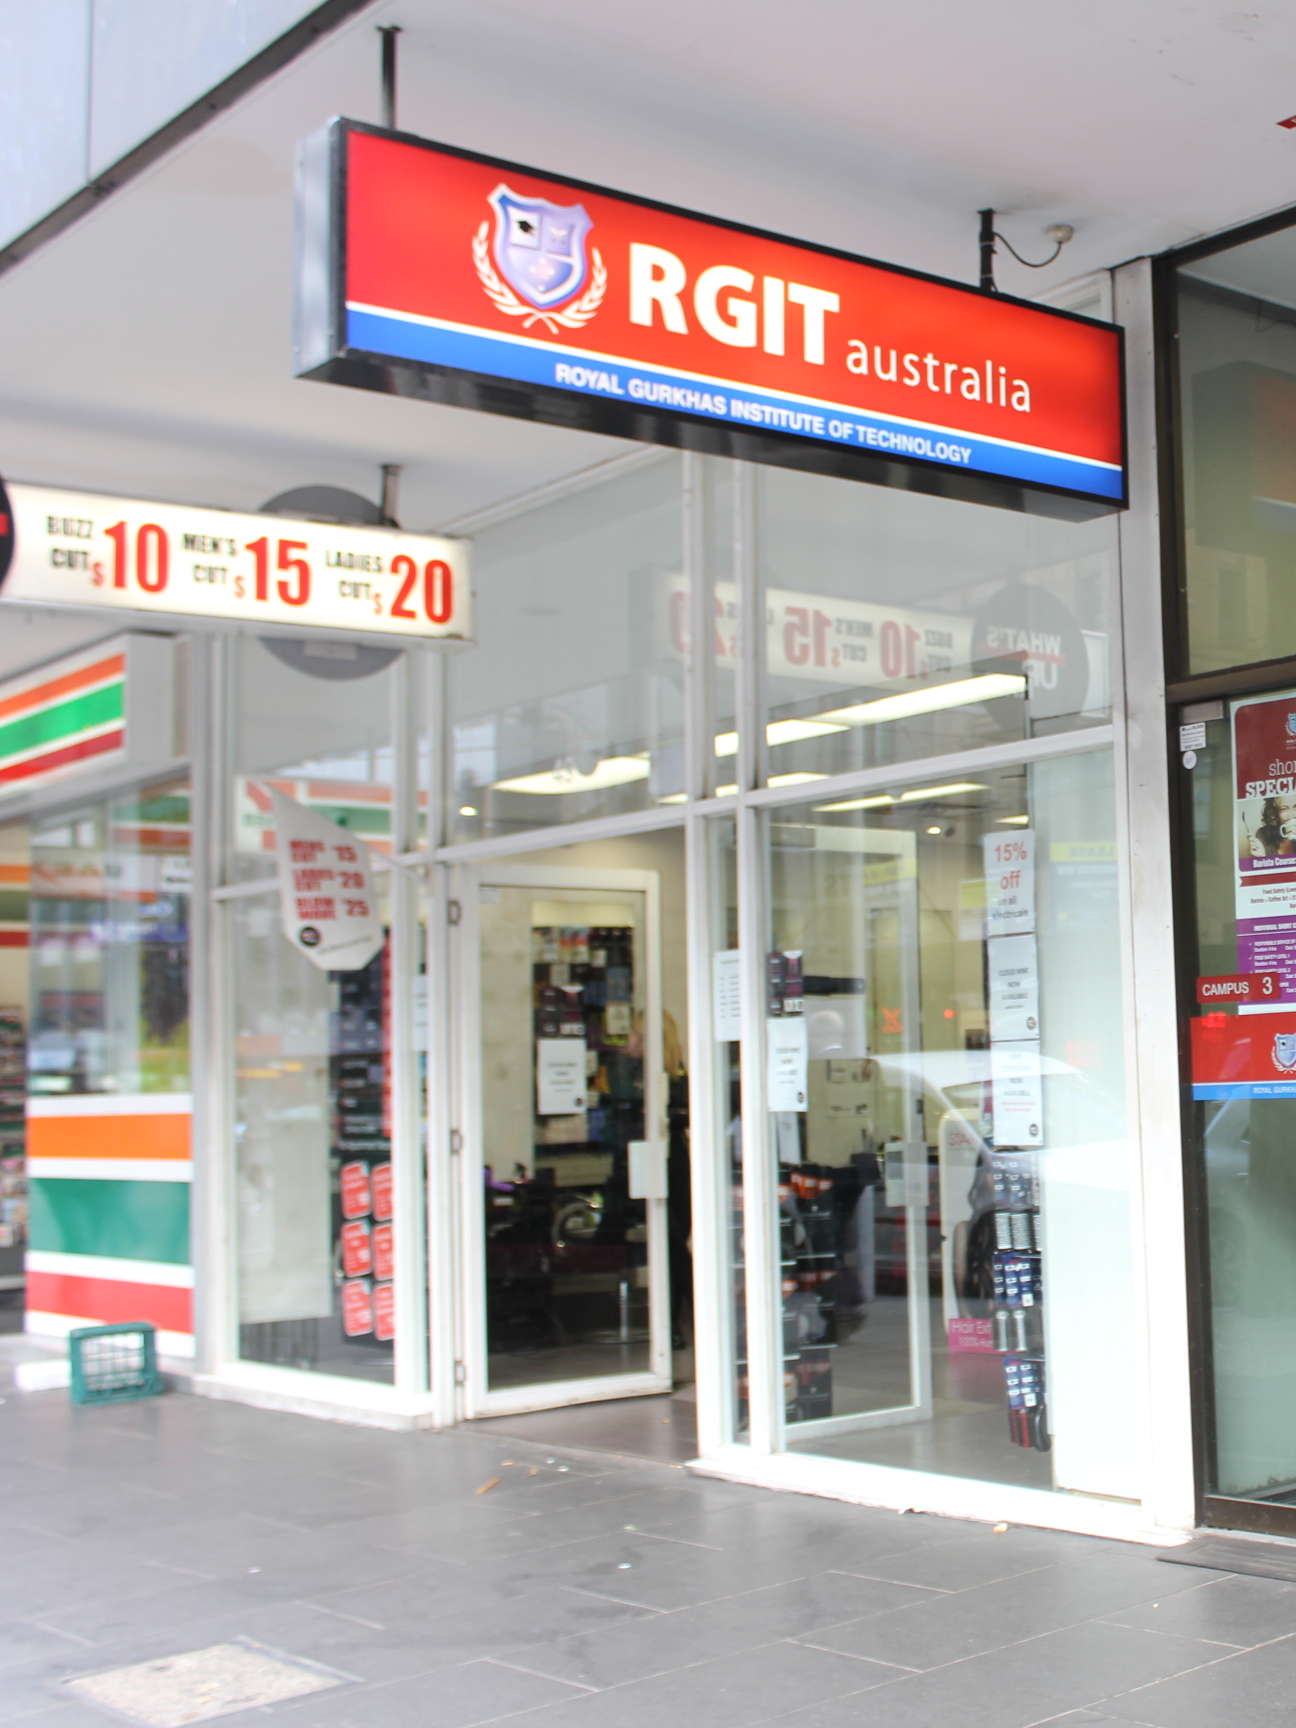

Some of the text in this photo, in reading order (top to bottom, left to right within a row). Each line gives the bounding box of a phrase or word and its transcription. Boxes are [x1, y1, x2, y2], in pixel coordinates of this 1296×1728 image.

[629, 242, 1031, 414] RGIT australia
[556, 363, 972, 464] ROYAL GURKHAS INSTITUTE OF TECHNOLOGY
[47, 515, 95, 540] BUZZ
[183, 532, 238, 557] MEN'S
[51, 547, 90, 572] CUT
[326, 549, 383, 574] LADIES
[194, 563, 227, 586] CUT
[339, 579, 371, 602] CUT
[995, 841, 1027, 863] 15%
[1253, 857, 1275, 869] Barista
[1000, 870, 1021, 890] off
[1202, 981, 1250, 997] CAMPUS
[1262, 976, 1273, 995] 3
[1253, 1086, 1273, 1094] ROYAL
